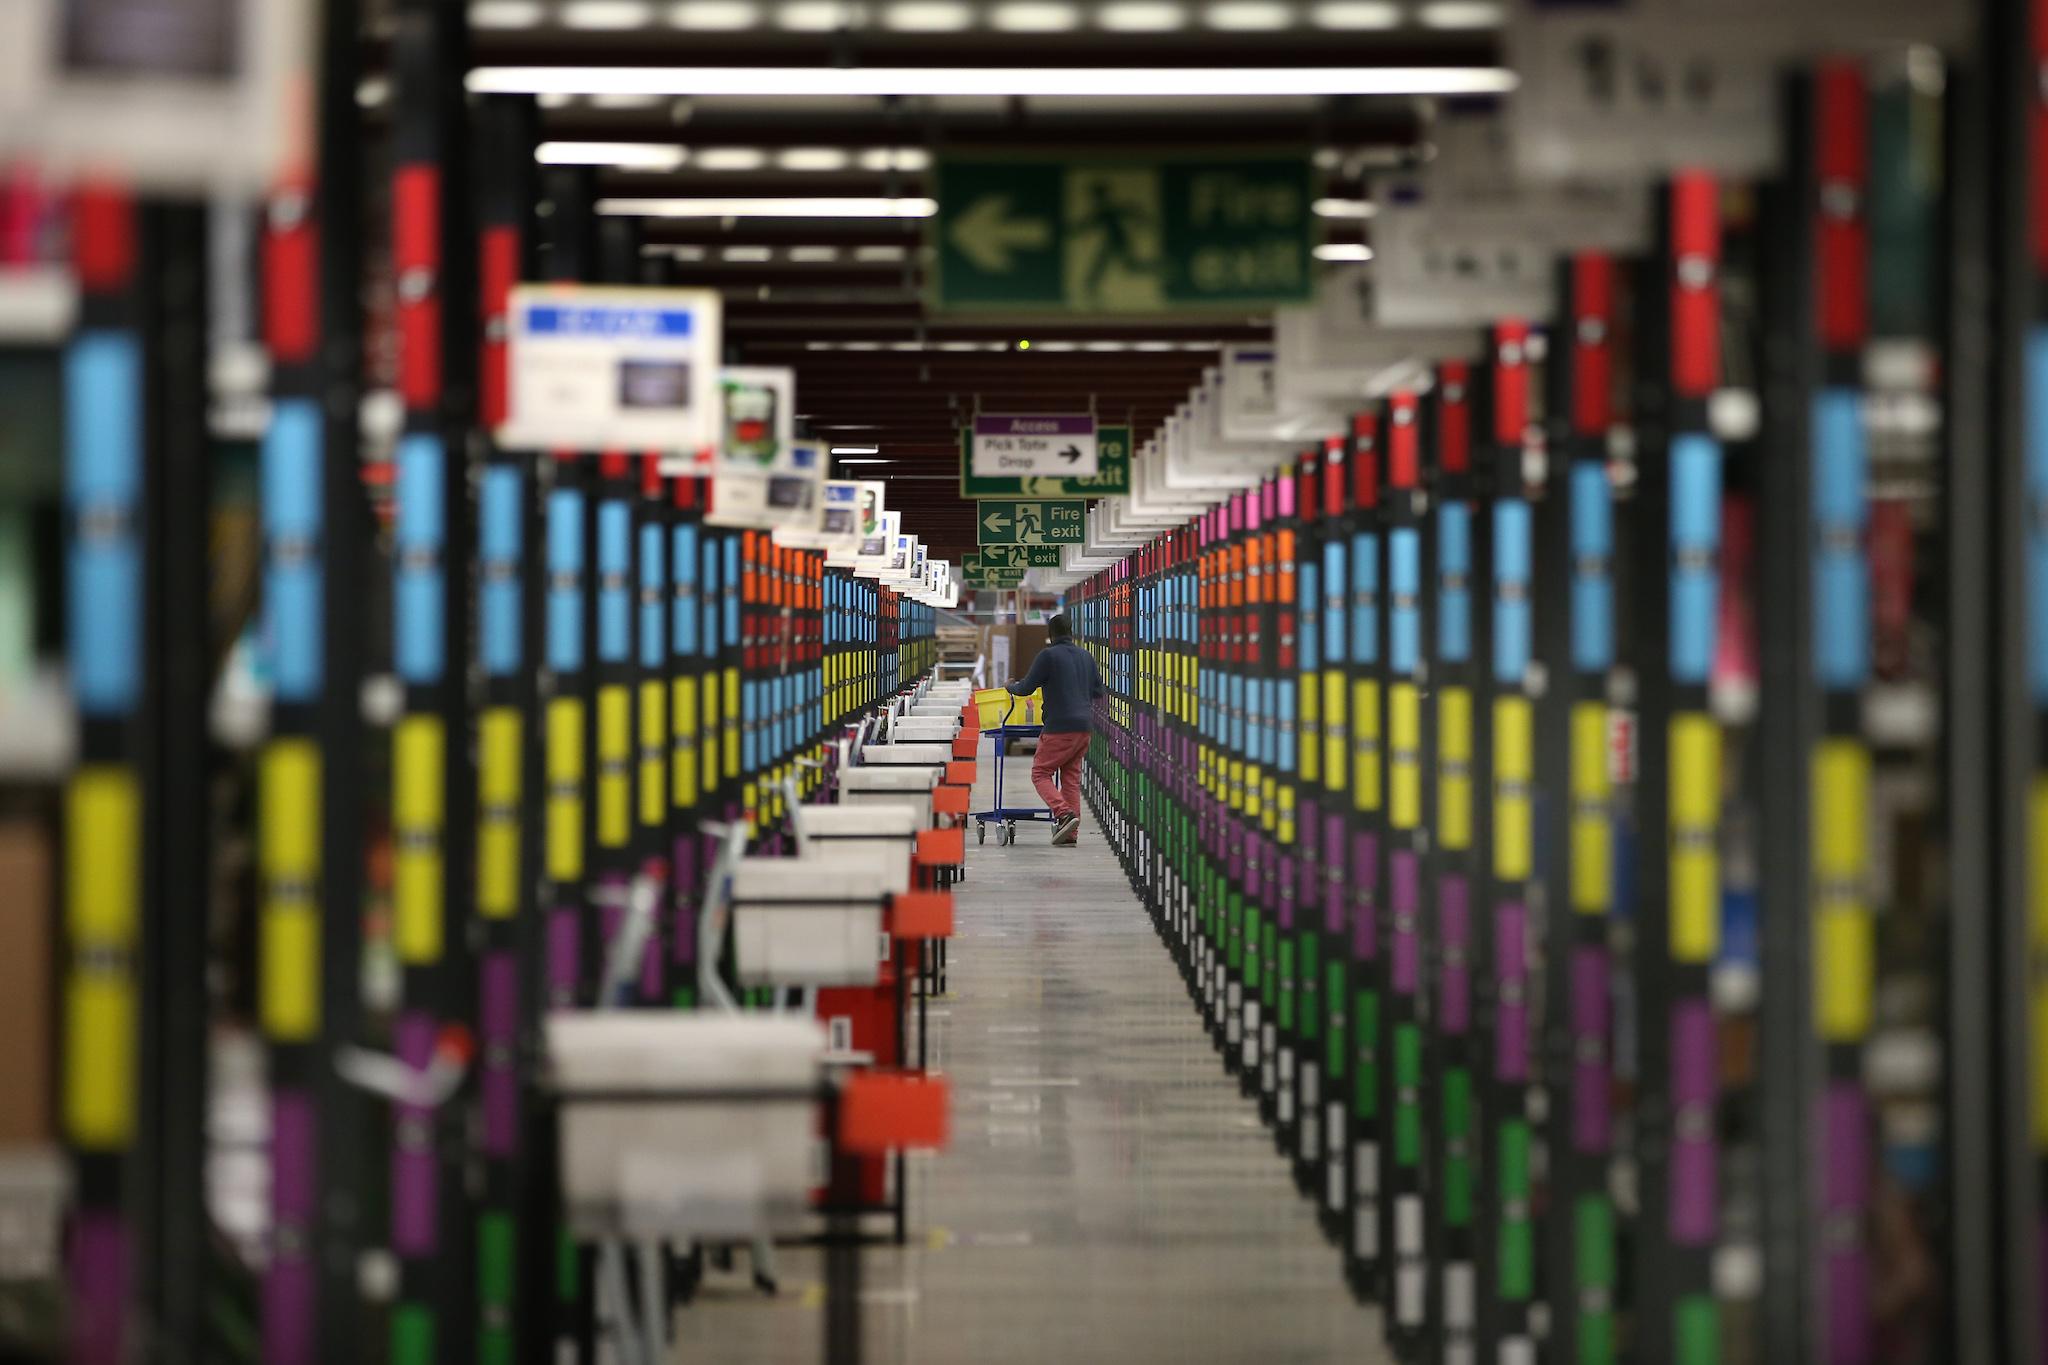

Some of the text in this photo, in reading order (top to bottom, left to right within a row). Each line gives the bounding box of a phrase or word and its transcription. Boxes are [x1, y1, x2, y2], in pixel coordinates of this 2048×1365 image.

[1010, 419, 1060, 432] Access
[984, 439, 1048, 450] Pick Tote
[1097, 441, 1122, 458] re
[998, 457, 1034, 469] Drop
[1051, 507, 1080, 520] Fire
[1051, 525, 1081, 538] exit
[1034, 552, 1057, 563] exit
